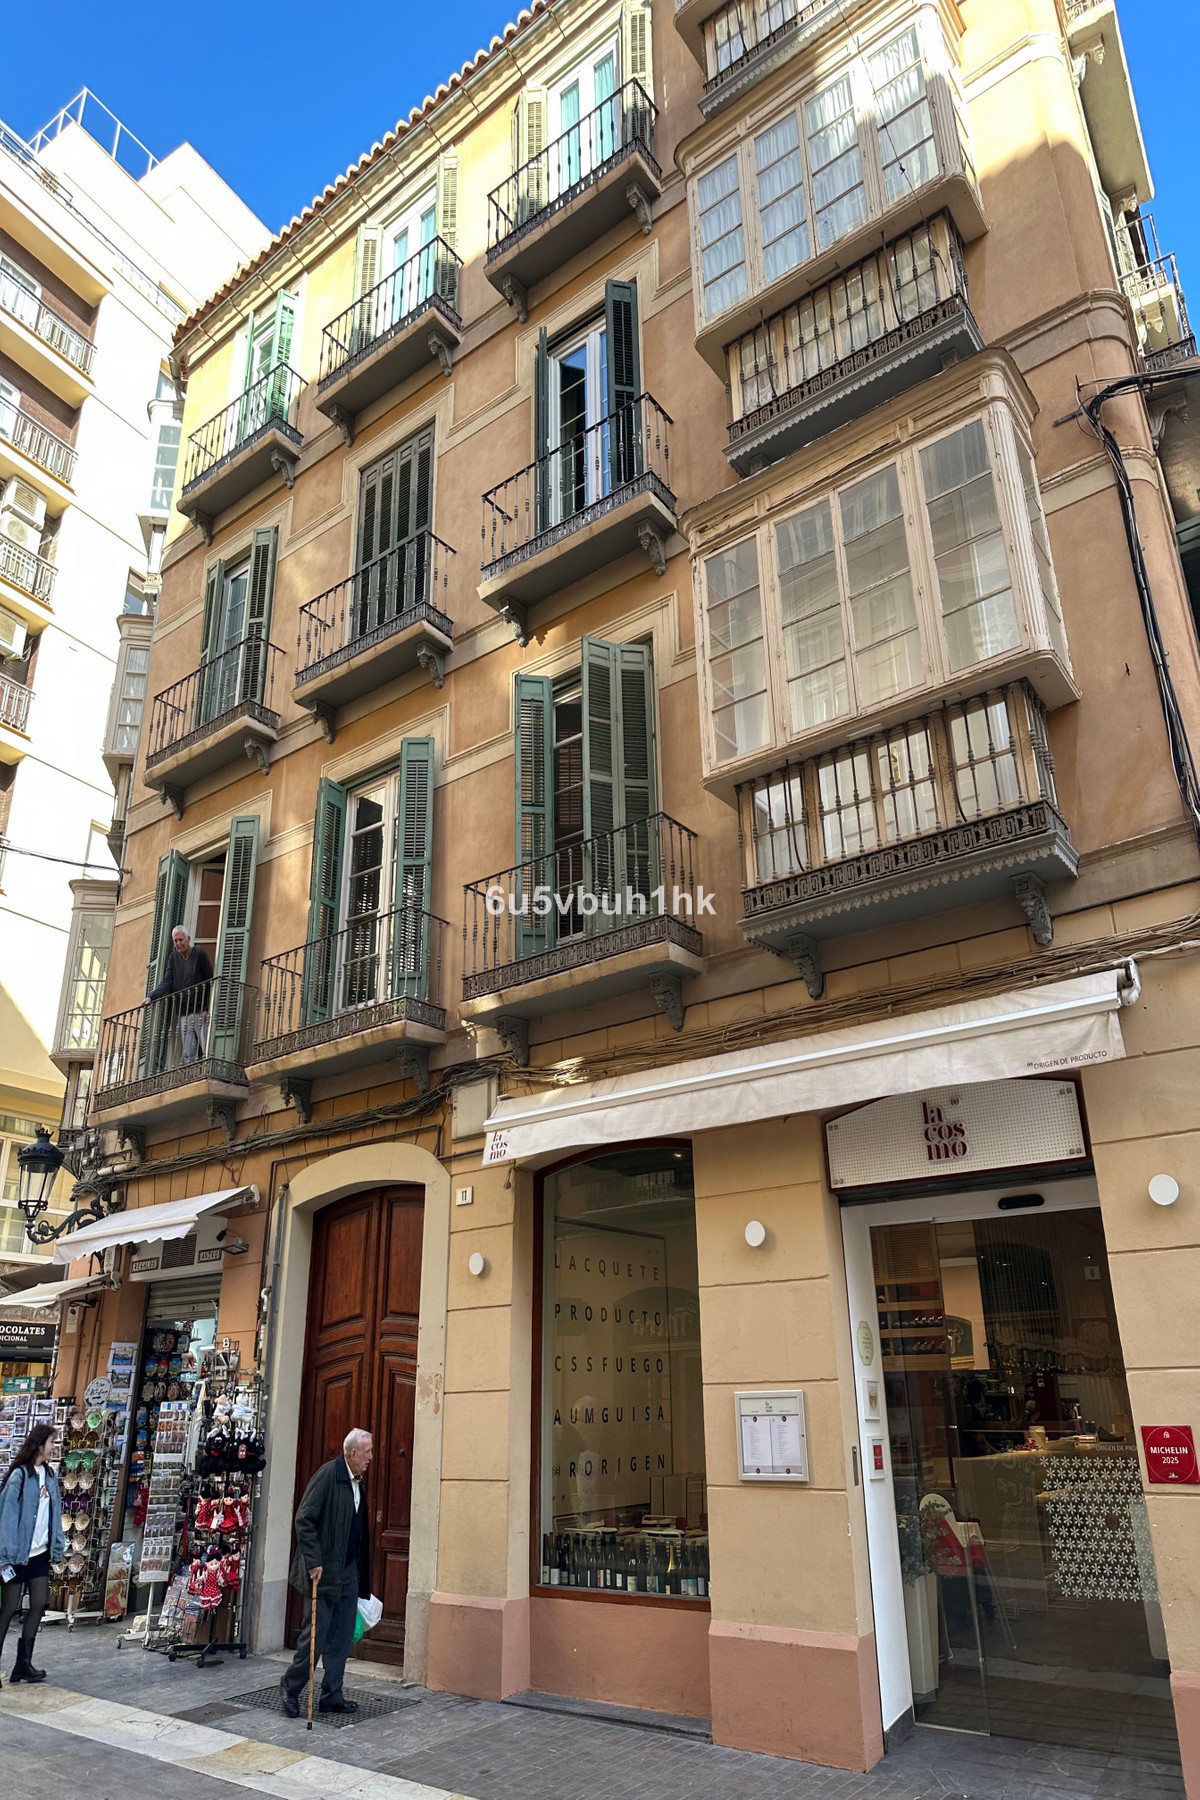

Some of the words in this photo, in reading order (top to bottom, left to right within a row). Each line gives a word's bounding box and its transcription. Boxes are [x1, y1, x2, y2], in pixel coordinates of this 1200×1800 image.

[1070, 1050, 1107, 1063] PRODUCTO
[922, 1101, 943, 1125] la
[492, 1131, 503, 1142] la
[924, 1122, 966, 1142] cos
[490, 1141, 508, 1151] cos
[927, 1141, 968, 1160] mo
[489, 1149, 507, 1160] mo
[461, 1190, 467, 1201] 11
[0, 1334, 28, 1342] ICIONAL
[1149, 1446, 1189, 1454] MICHELIN
[1161, 1456, 1180, 1464] 2025
